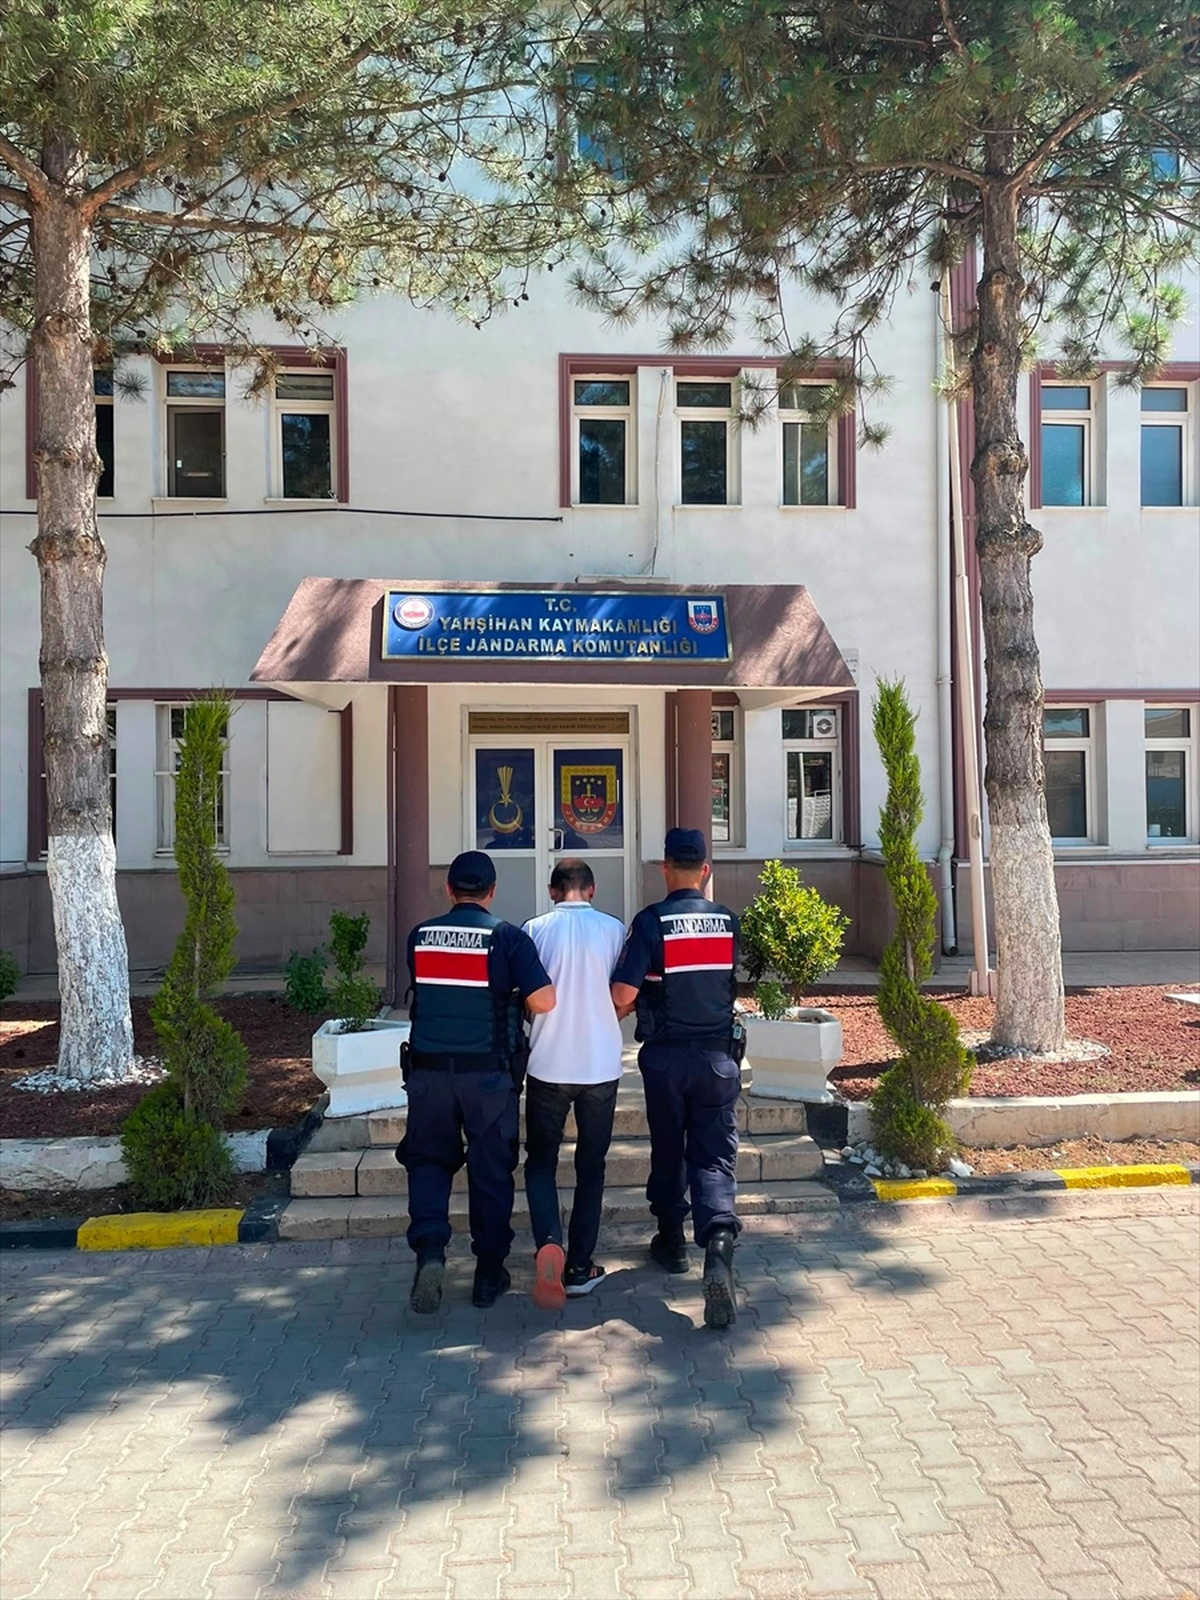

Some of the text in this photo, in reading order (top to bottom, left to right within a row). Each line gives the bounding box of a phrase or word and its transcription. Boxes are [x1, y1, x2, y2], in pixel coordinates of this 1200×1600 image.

[544, 598, 578, 612] T.C.
[440, 614, 532, 634] YAHŞİHAN
[539, 616, 677, 634] KAYMAKAMLIĞI
[418, 635, 698, 655] İLÇE JANDARMA KOMUTANLIĞI
[671, 918, 727, 934] JANDARMA
[420, 930, 484, 948] JANDARMA
